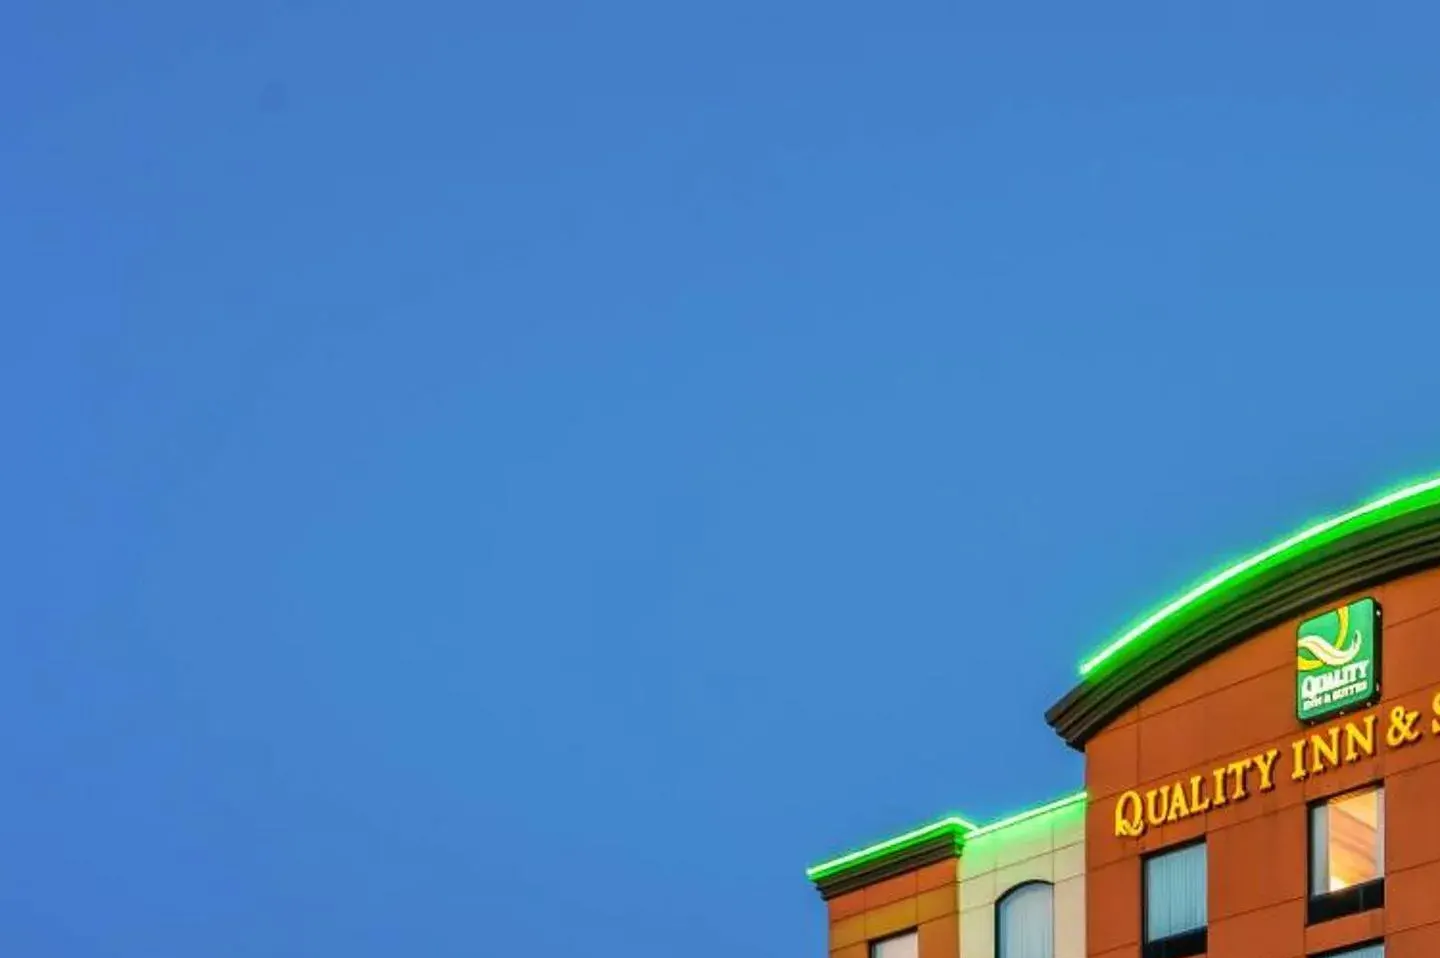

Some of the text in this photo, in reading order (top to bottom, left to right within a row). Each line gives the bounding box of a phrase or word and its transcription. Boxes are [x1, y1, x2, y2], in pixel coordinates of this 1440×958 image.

[1301, 658, 1369, 701] QUALITY
[1114, 748, 1279, 838] QUALITY
[1291, 714, 1377, 780] INN
[1387, 705, 1421, 747] &
